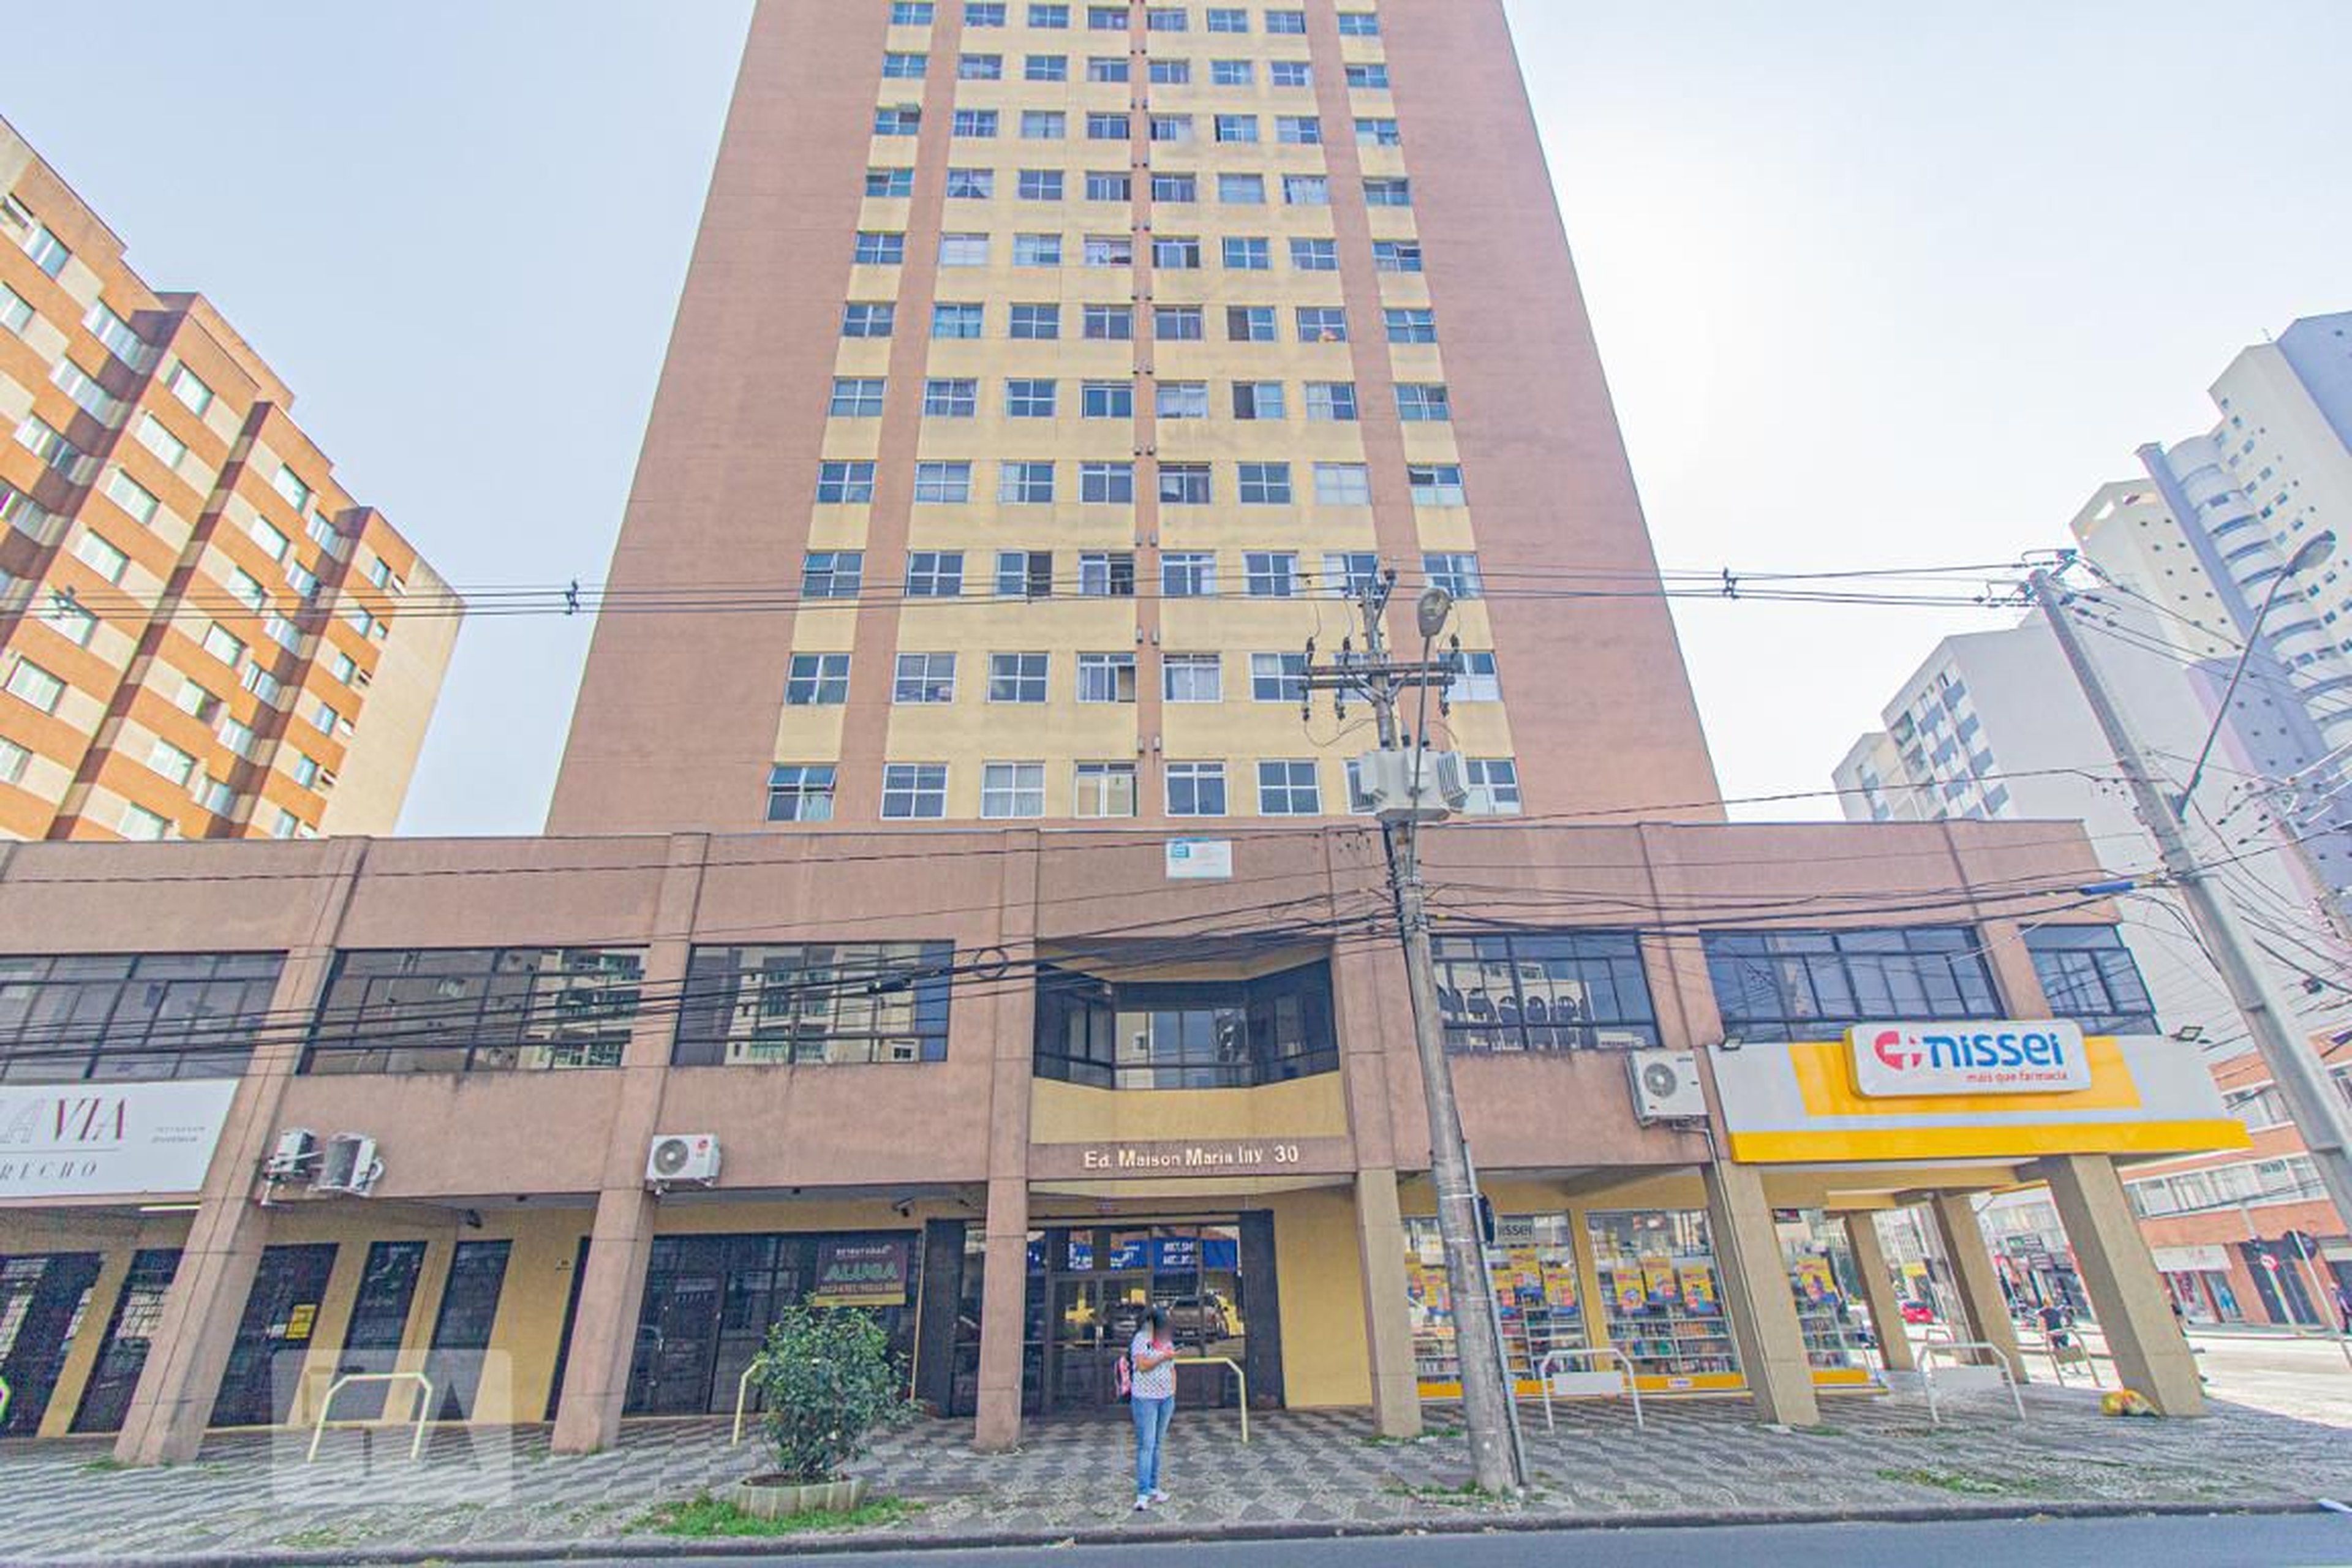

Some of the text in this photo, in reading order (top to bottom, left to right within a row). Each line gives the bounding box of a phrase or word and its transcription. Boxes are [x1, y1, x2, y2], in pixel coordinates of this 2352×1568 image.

[1922, 1032, 2064, 1068] nissei
[1118, 1149, 1180, 1167] Maison
[1275, 1144, 1298, 1163] 30
